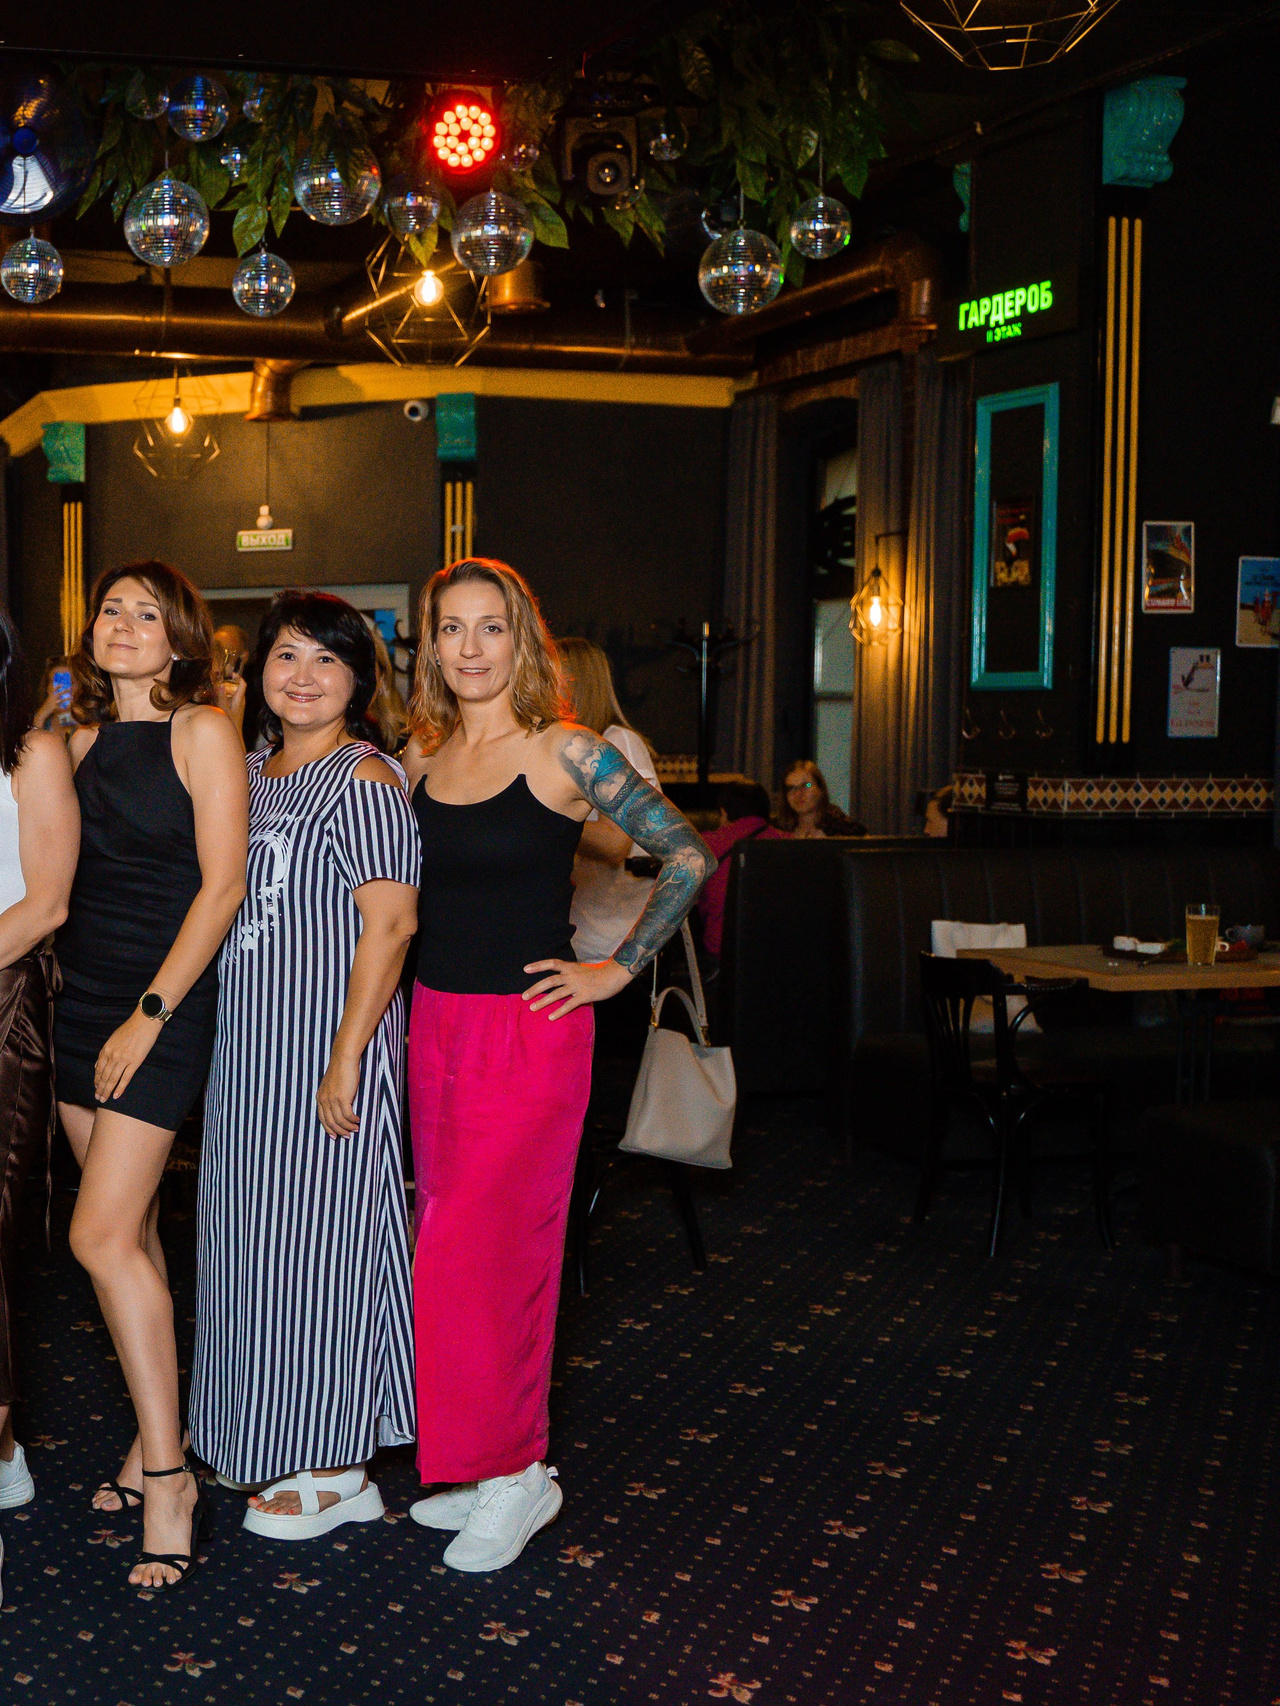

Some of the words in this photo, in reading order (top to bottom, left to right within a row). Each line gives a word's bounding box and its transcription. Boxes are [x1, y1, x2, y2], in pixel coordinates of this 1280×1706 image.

[958, 280, 1053, 331] ГАРДЕРОБ
[994, 322, 1022, 342] ЭТАЖ
[241, 533, 286, 547] ВЫХОД
